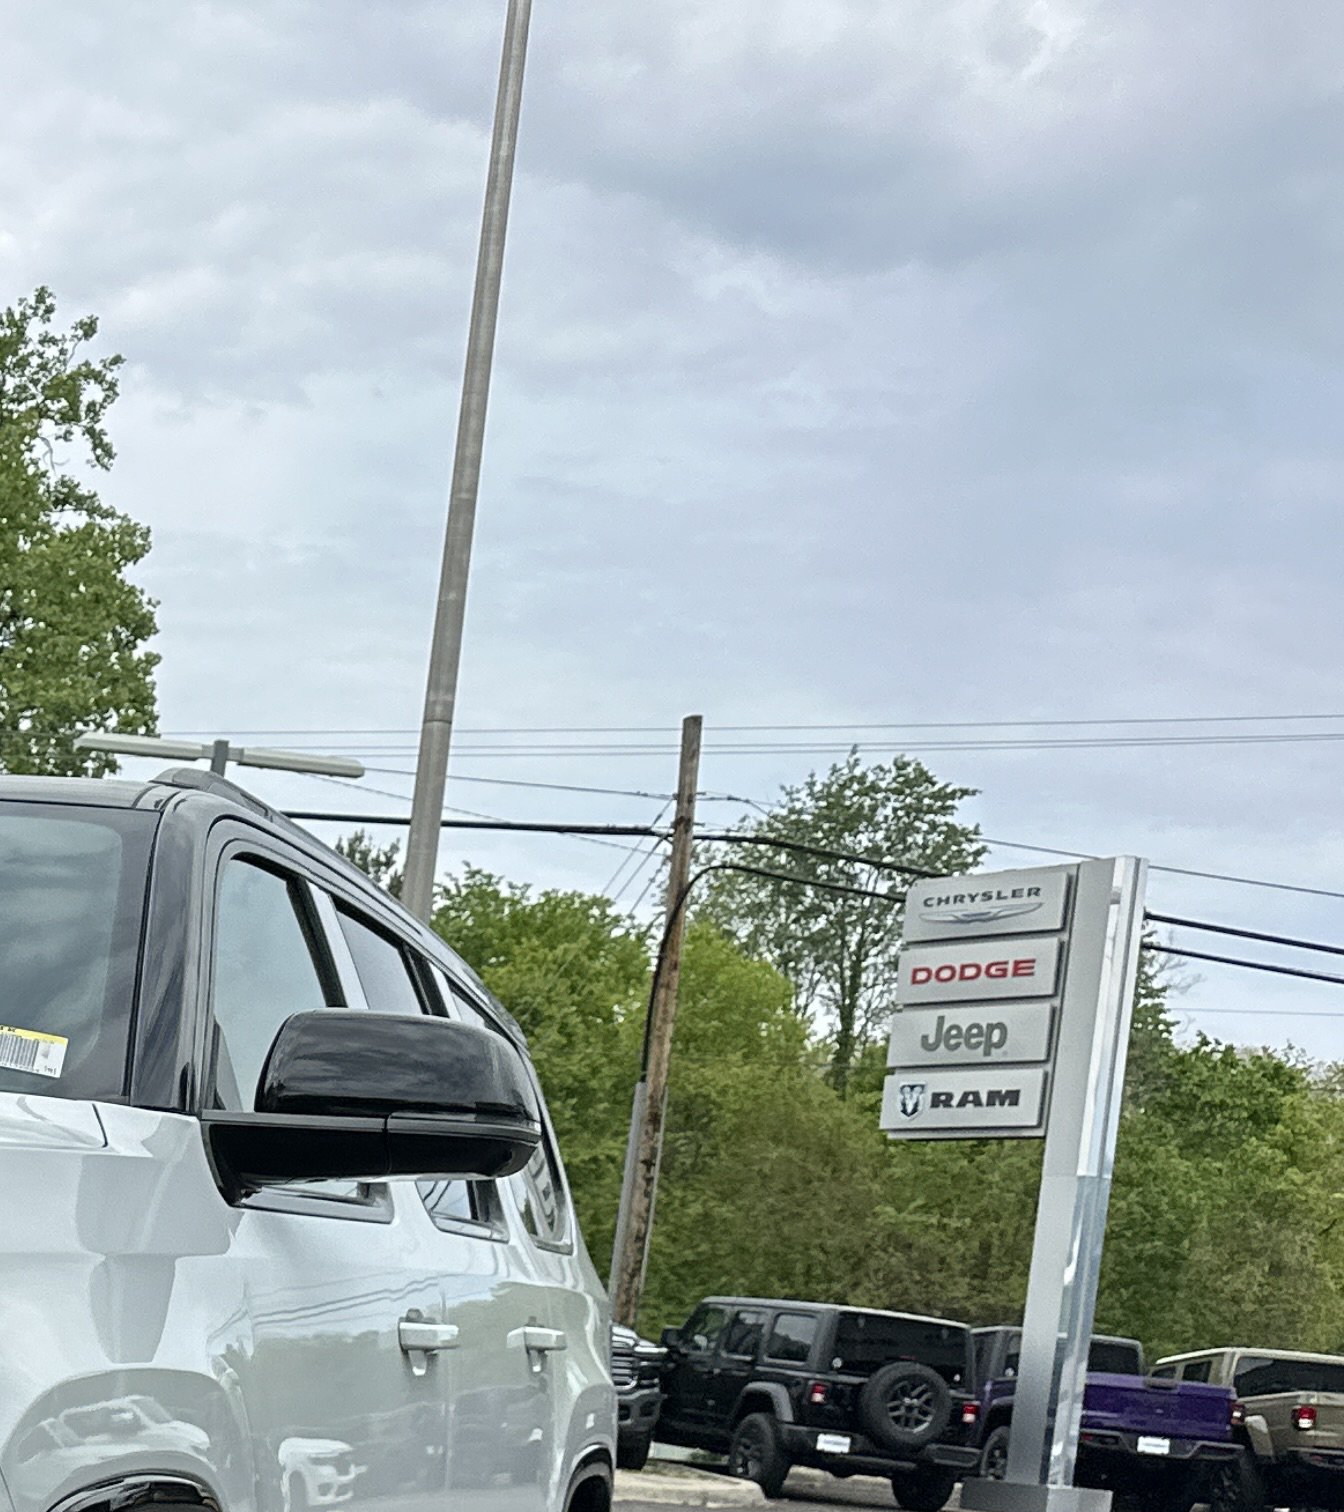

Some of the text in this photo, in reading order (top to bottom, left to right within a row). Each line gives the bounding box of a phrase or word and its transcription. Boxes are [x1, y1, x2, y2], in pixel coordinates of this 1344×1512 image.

[923, 886, 1041, 908] CHRYSLER
[911, 959, 1037, 985] DODGE
[920, 1016, 1008, 1056] Jeep
[929, 1089, 1021, 1108] RAM
